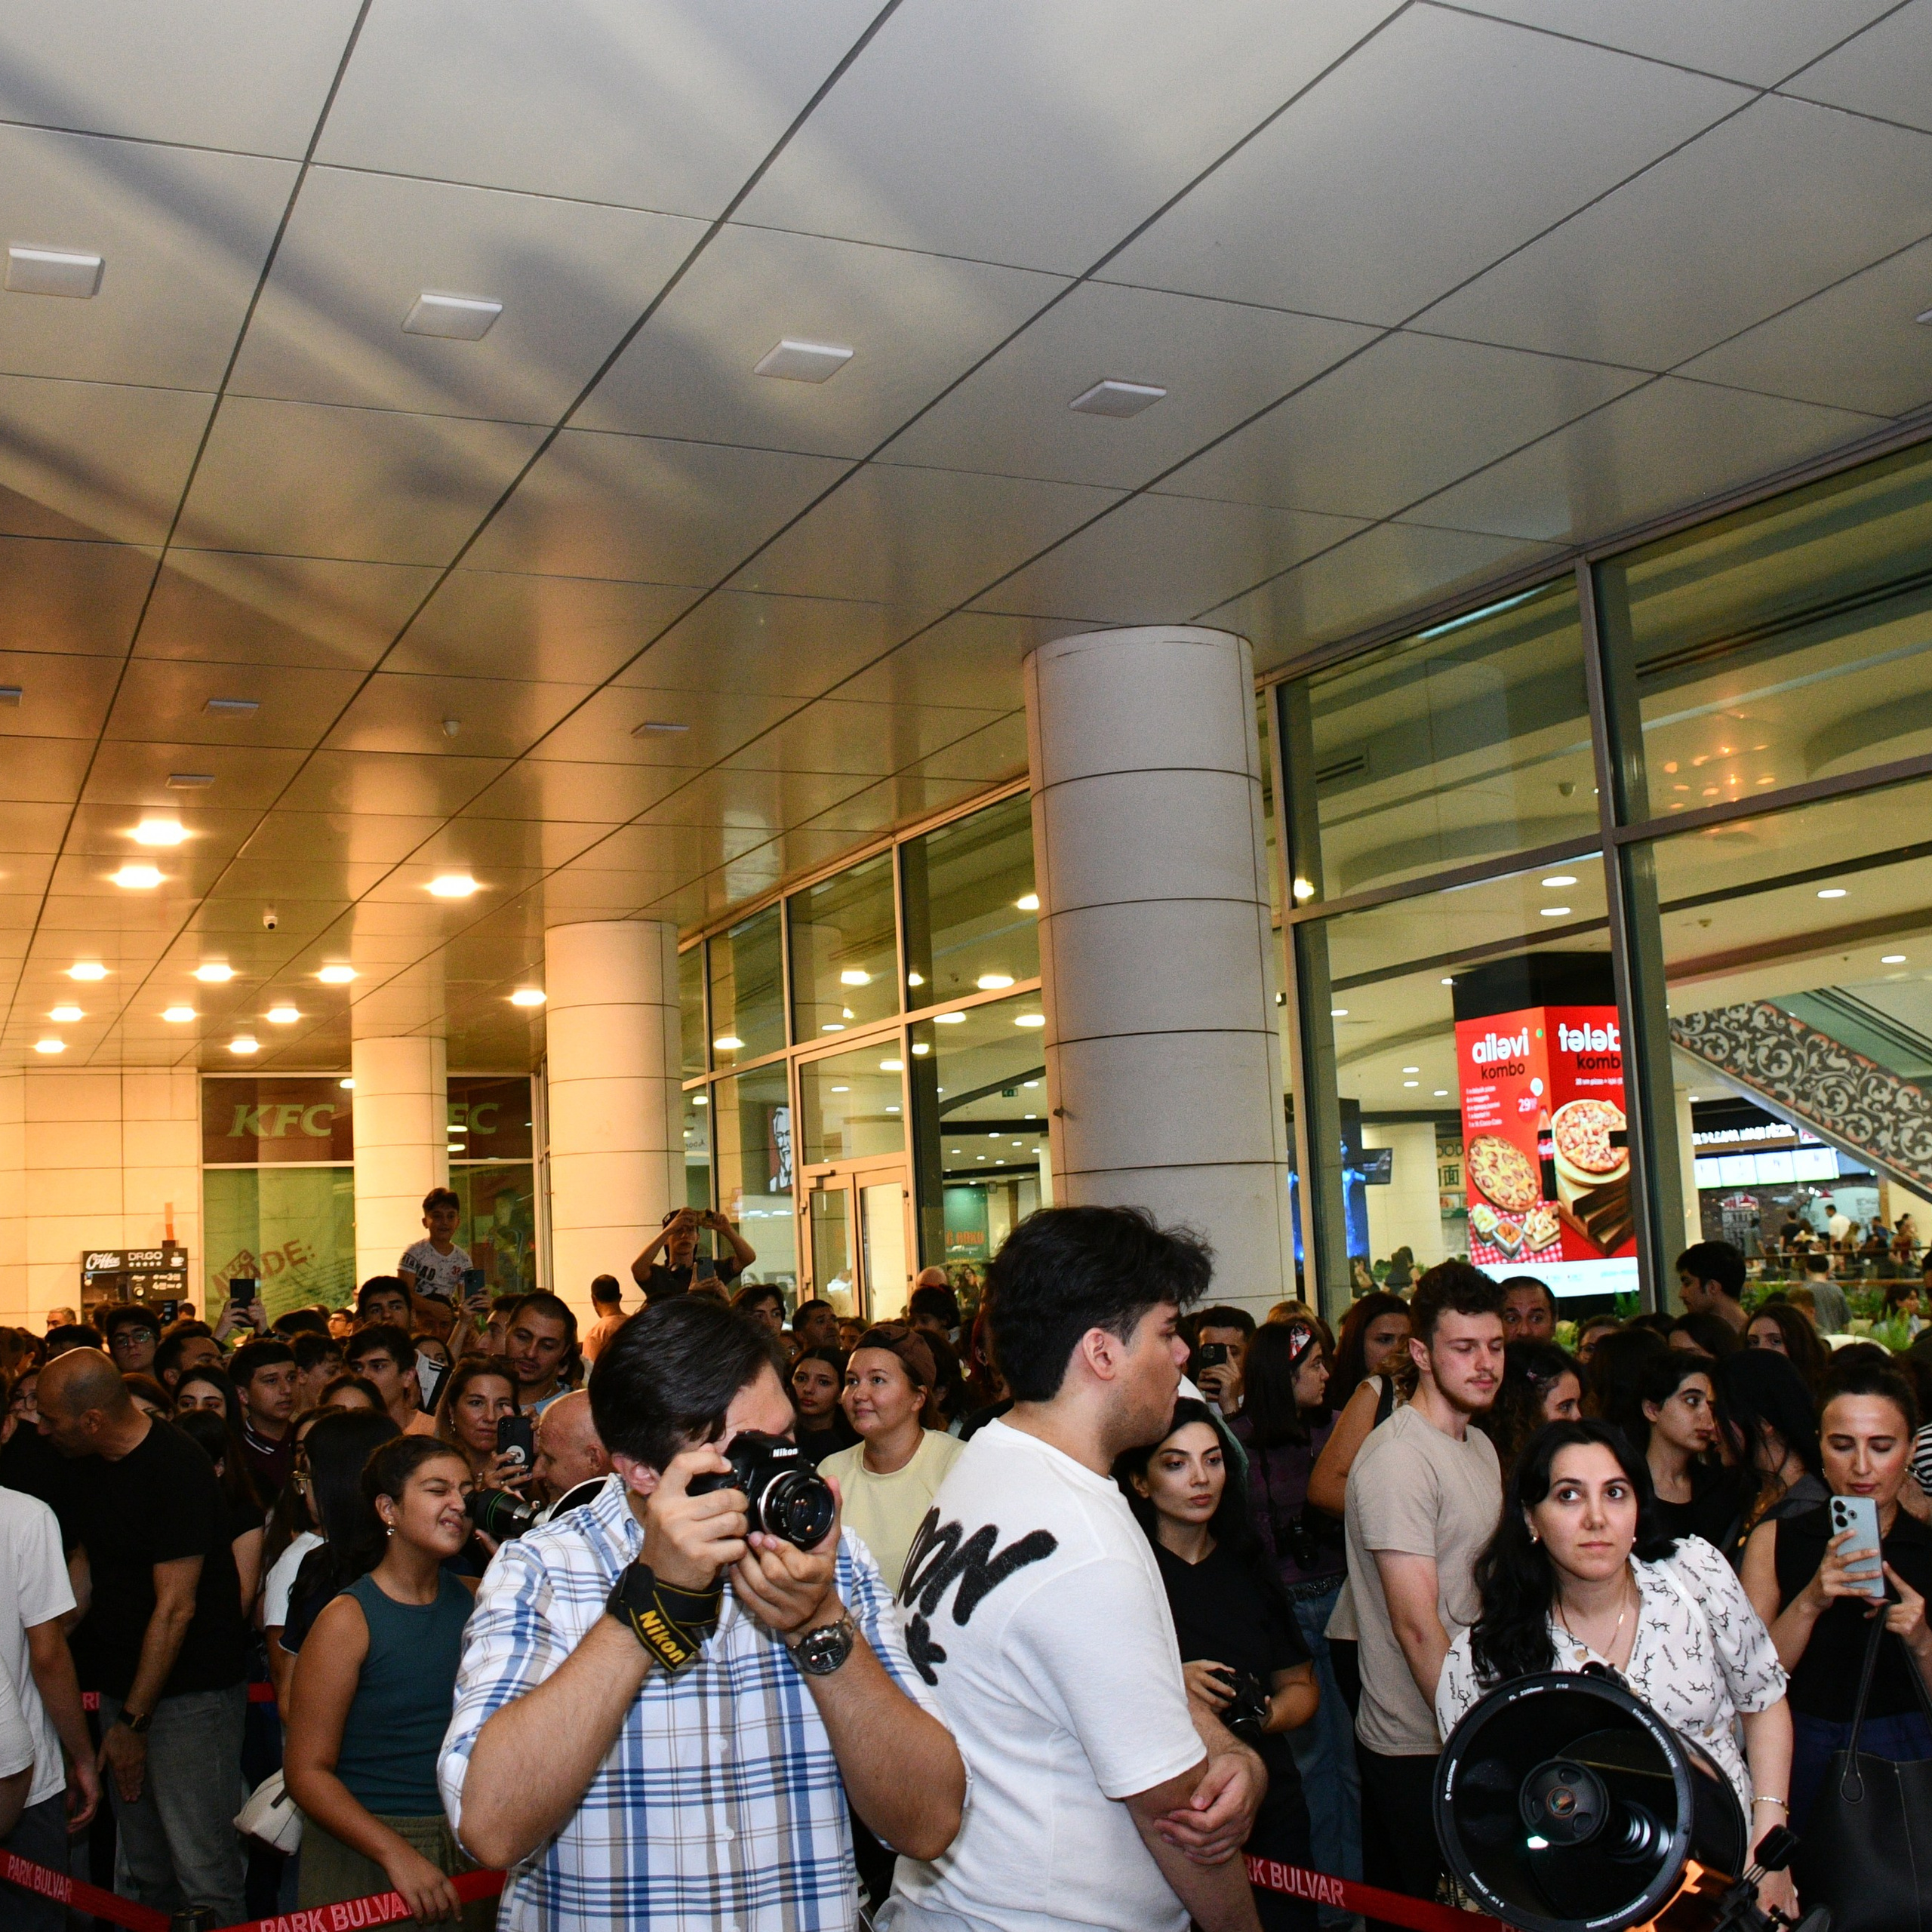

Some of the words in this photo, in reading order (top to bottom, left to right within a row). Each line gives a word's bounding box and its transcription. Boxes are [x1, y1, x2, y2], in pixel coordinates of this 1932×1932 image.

[1472, 1027, 1530, 1063] ailəvi
[1558, 1023, 1621, 1052] tələb
[1481, 1060, 1525, 1079] kombo
[1577, 1054, 1621, 1069] komb
[227, 1103, 334, 1137] KFC
[448, 1103, 500, 1134] FC
[85, 1252, 120, 1270] Coffee
[772, 1447, 798, 1458] Nikon
[638, 1610, 686, 1663] Nikon
[1633, 1629, 1644, 1661] Perfumes
[1666, 1682, 1693, 1706] Perfumes
[1632, 1707, 1652, 1727] OPTICS
[8, 1854, 34, 1887] PARK
[33, 1865, 73, 1903] BULVAR
[1246, 1856, 1266, 1884] RK
[1269, 1860, 1346, 1908] BULVAR
[260, 1908, 328, 1932] PARK
[330, 1892, 413, 1931] BULVA
